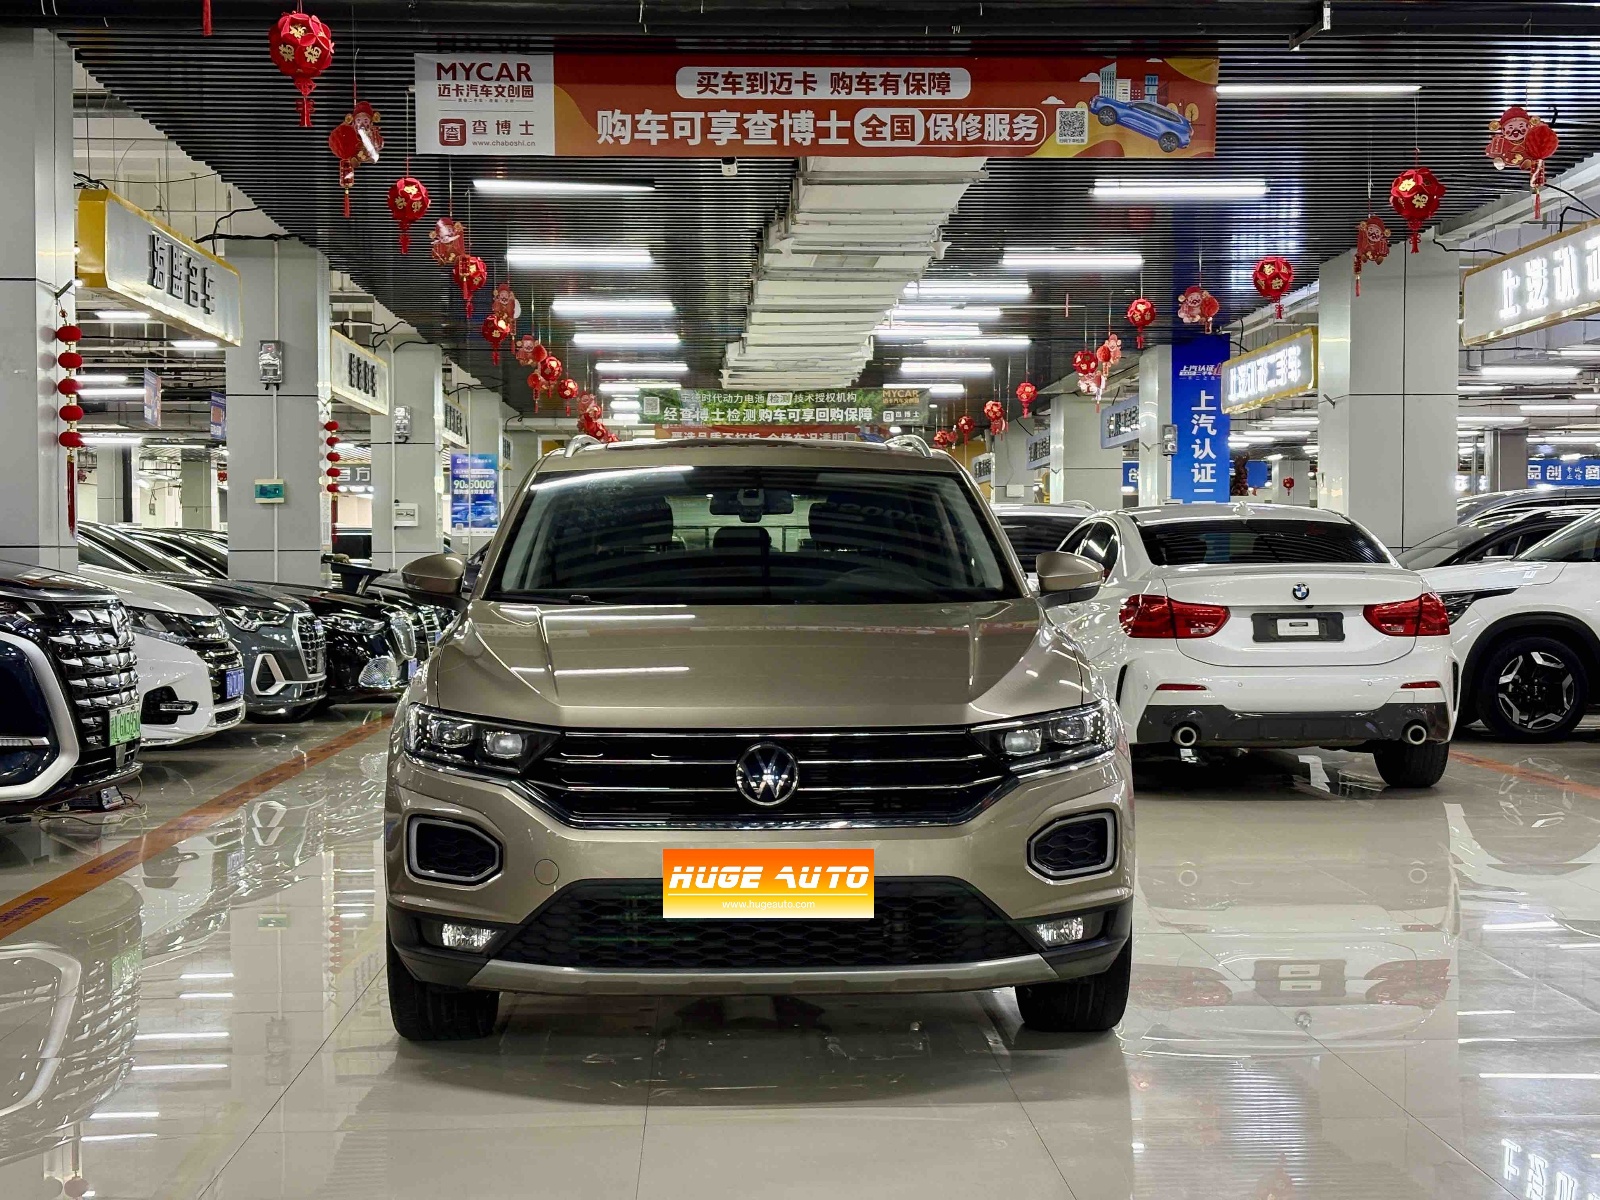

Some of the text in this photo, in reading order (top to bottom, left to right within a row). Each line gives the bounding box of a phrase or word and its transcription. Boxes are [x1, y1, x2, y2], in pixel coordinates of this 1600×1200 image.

[436, 62, 533, 82] MYCAR
[437, 84, 534, 98] 迈卡汽车文创园
[696, 70, 951, 96] 买车到迈卡 购车有保障
[471, 119, 535, 136] 查博士
[596, 108, 1039, 146] 购车可享查博士 全国 保修服务
[471, 139, 536, 147] www.chaboshi.cn
[882, 389, 919, 398] MYCAR
